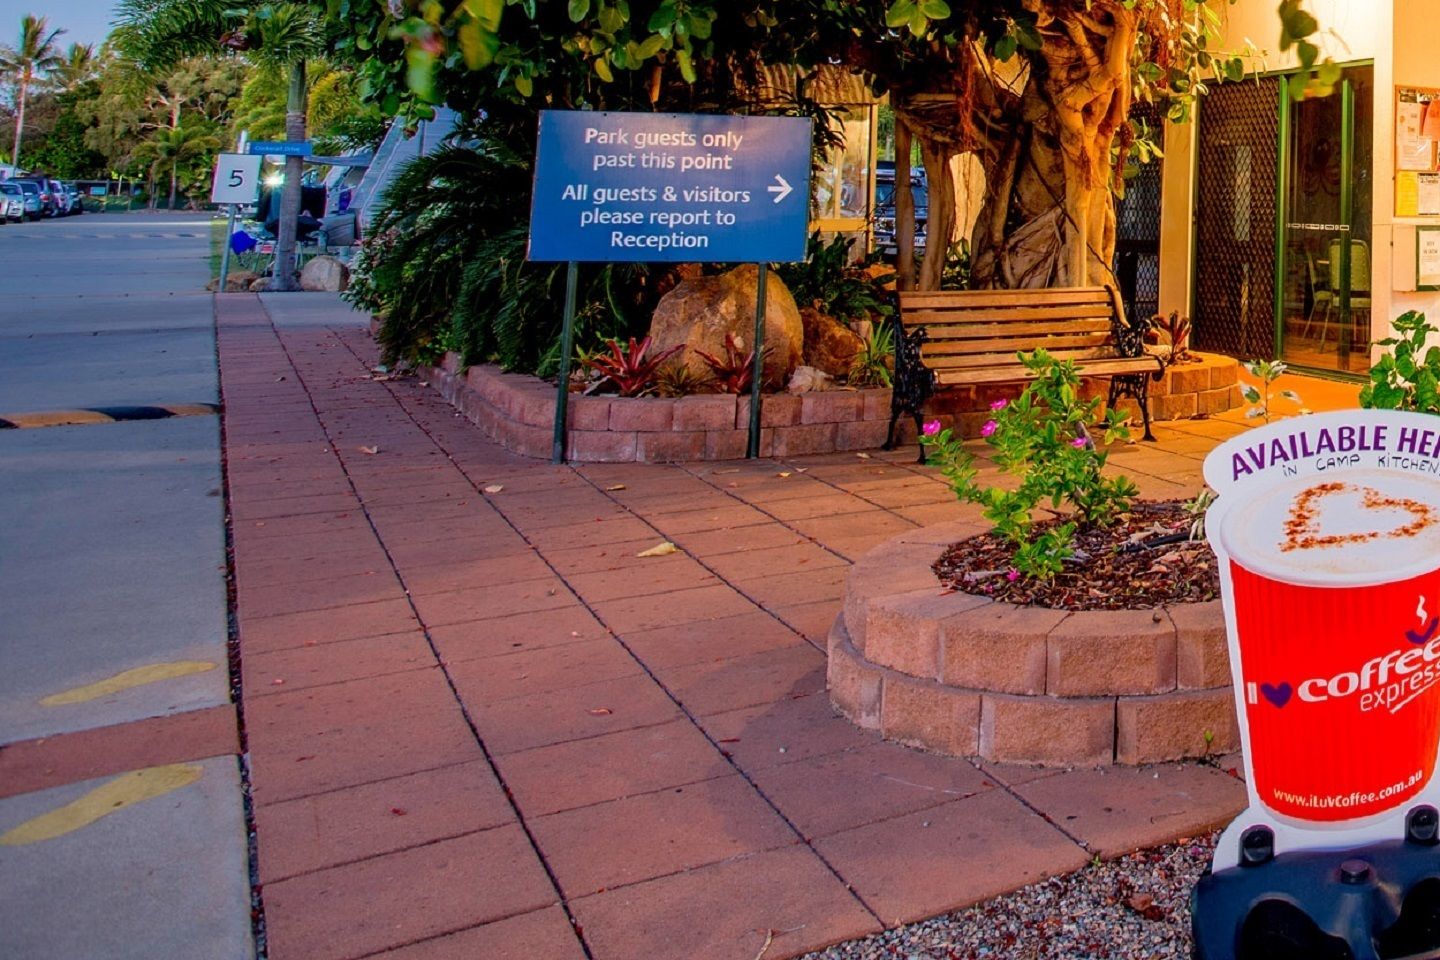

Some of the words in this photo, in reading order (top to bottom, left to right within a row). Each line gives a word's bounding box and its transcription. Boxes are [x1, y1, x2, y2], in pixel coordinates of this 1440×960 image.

[584, 127, 627, 145] Park
[634, 130, 696, 149] guests
[702, 130, 743, 151] only
[593, 154, 636, 171] past
[641, 153, 675, 168] this
[680, 154, 732, 172] point
[228, 169, 244, 187] 5
[561, 184, 588, 201] All
[593, 186, 656, 205] guests
[662, 186, 678, 203] &
[683, 186, 751, 203] visitors
[580, 208, 643, 227] please
[650, 209, 709, 229] report
[715, 210, 736, 225] to
[611, 231, 709, 251] Reception
[1231, 425, 1389, 482] AVAILABLE
[1316, 453, 1360, 471] CAMP
[1246, 681, 1258, 704] I
